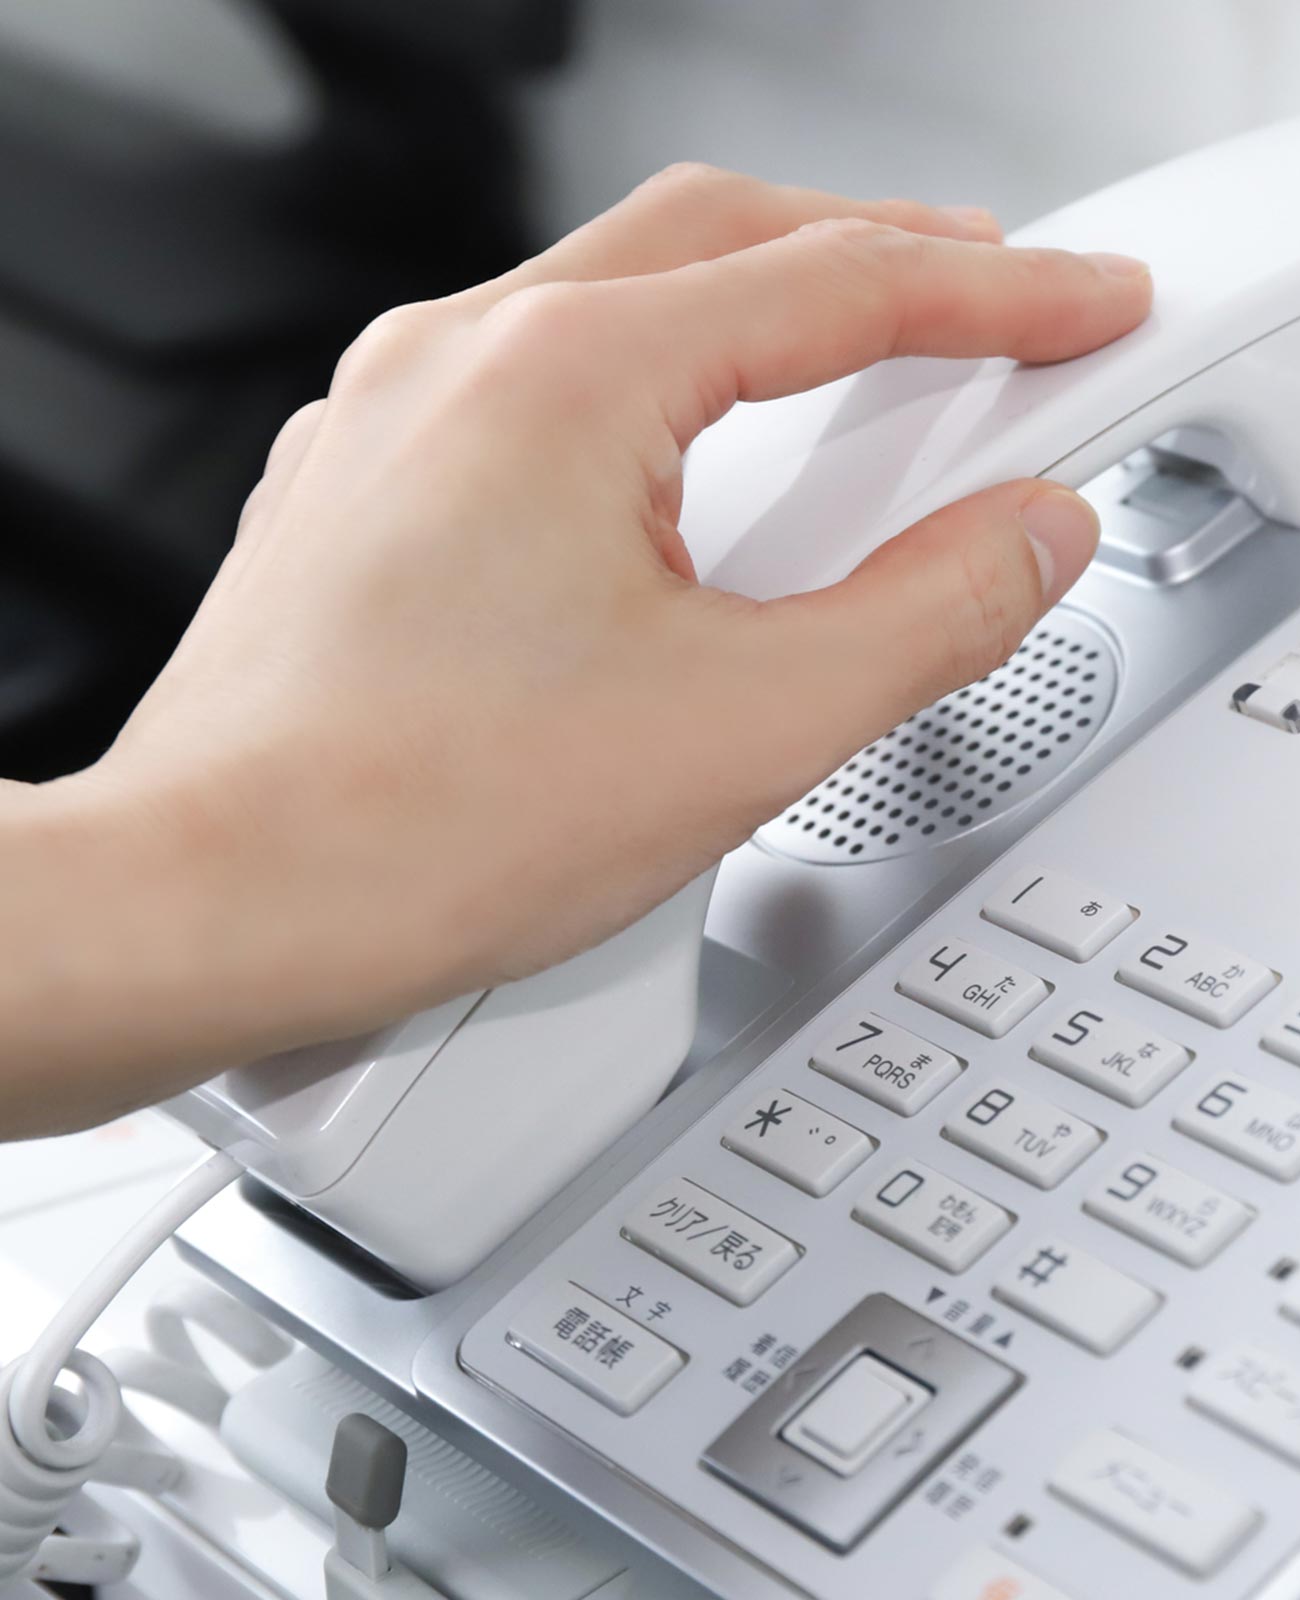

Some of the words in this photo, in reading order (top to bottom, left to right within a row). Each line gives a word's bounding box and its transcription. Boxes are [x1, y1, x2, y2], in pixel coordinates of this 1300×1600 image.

[1011, 876, 1044, 905] 1
[1079, 901, 1103, 917] あ
[929, 945, 968, 982] 4
[1139, 934, 1189, 971] 2
[993, 974, 1017, 994] た
[1184, 971, 1232, 999] ABC
[1222, 963, 1245, 980] か
[962, 984, 1001, 1010] GHI
[835, 1020, 884, 1052] 7
[1051, 1010, 1104, 1046] 5
[862, 1053, 916, 1090] PQRS
[910, 1053, 933, 1070] ま
[1101, 1051, 1135, 1077] JKL
[965, 1088, 1015, 1126] 8
[1196, 1080, 1248, 1119] 6
[1015, 1127, 1056, 1158] TUV
[1052, 1123, 1072, 1139] や
[1245, 1118, 1296, 1152] MNO
[875, 1169, 925, 1209] 0
[1106, 1162, 1158, 1202] 9
[649, 1196, 764, 1271] クリア/戻る
[1146, 1197, 1208, 1238] WXYZ
[1016, 1247, 1068, 1288] #
[615, 1284, 672, 1322] 文字
[552, 1305, 635, 1370] 電話帳
